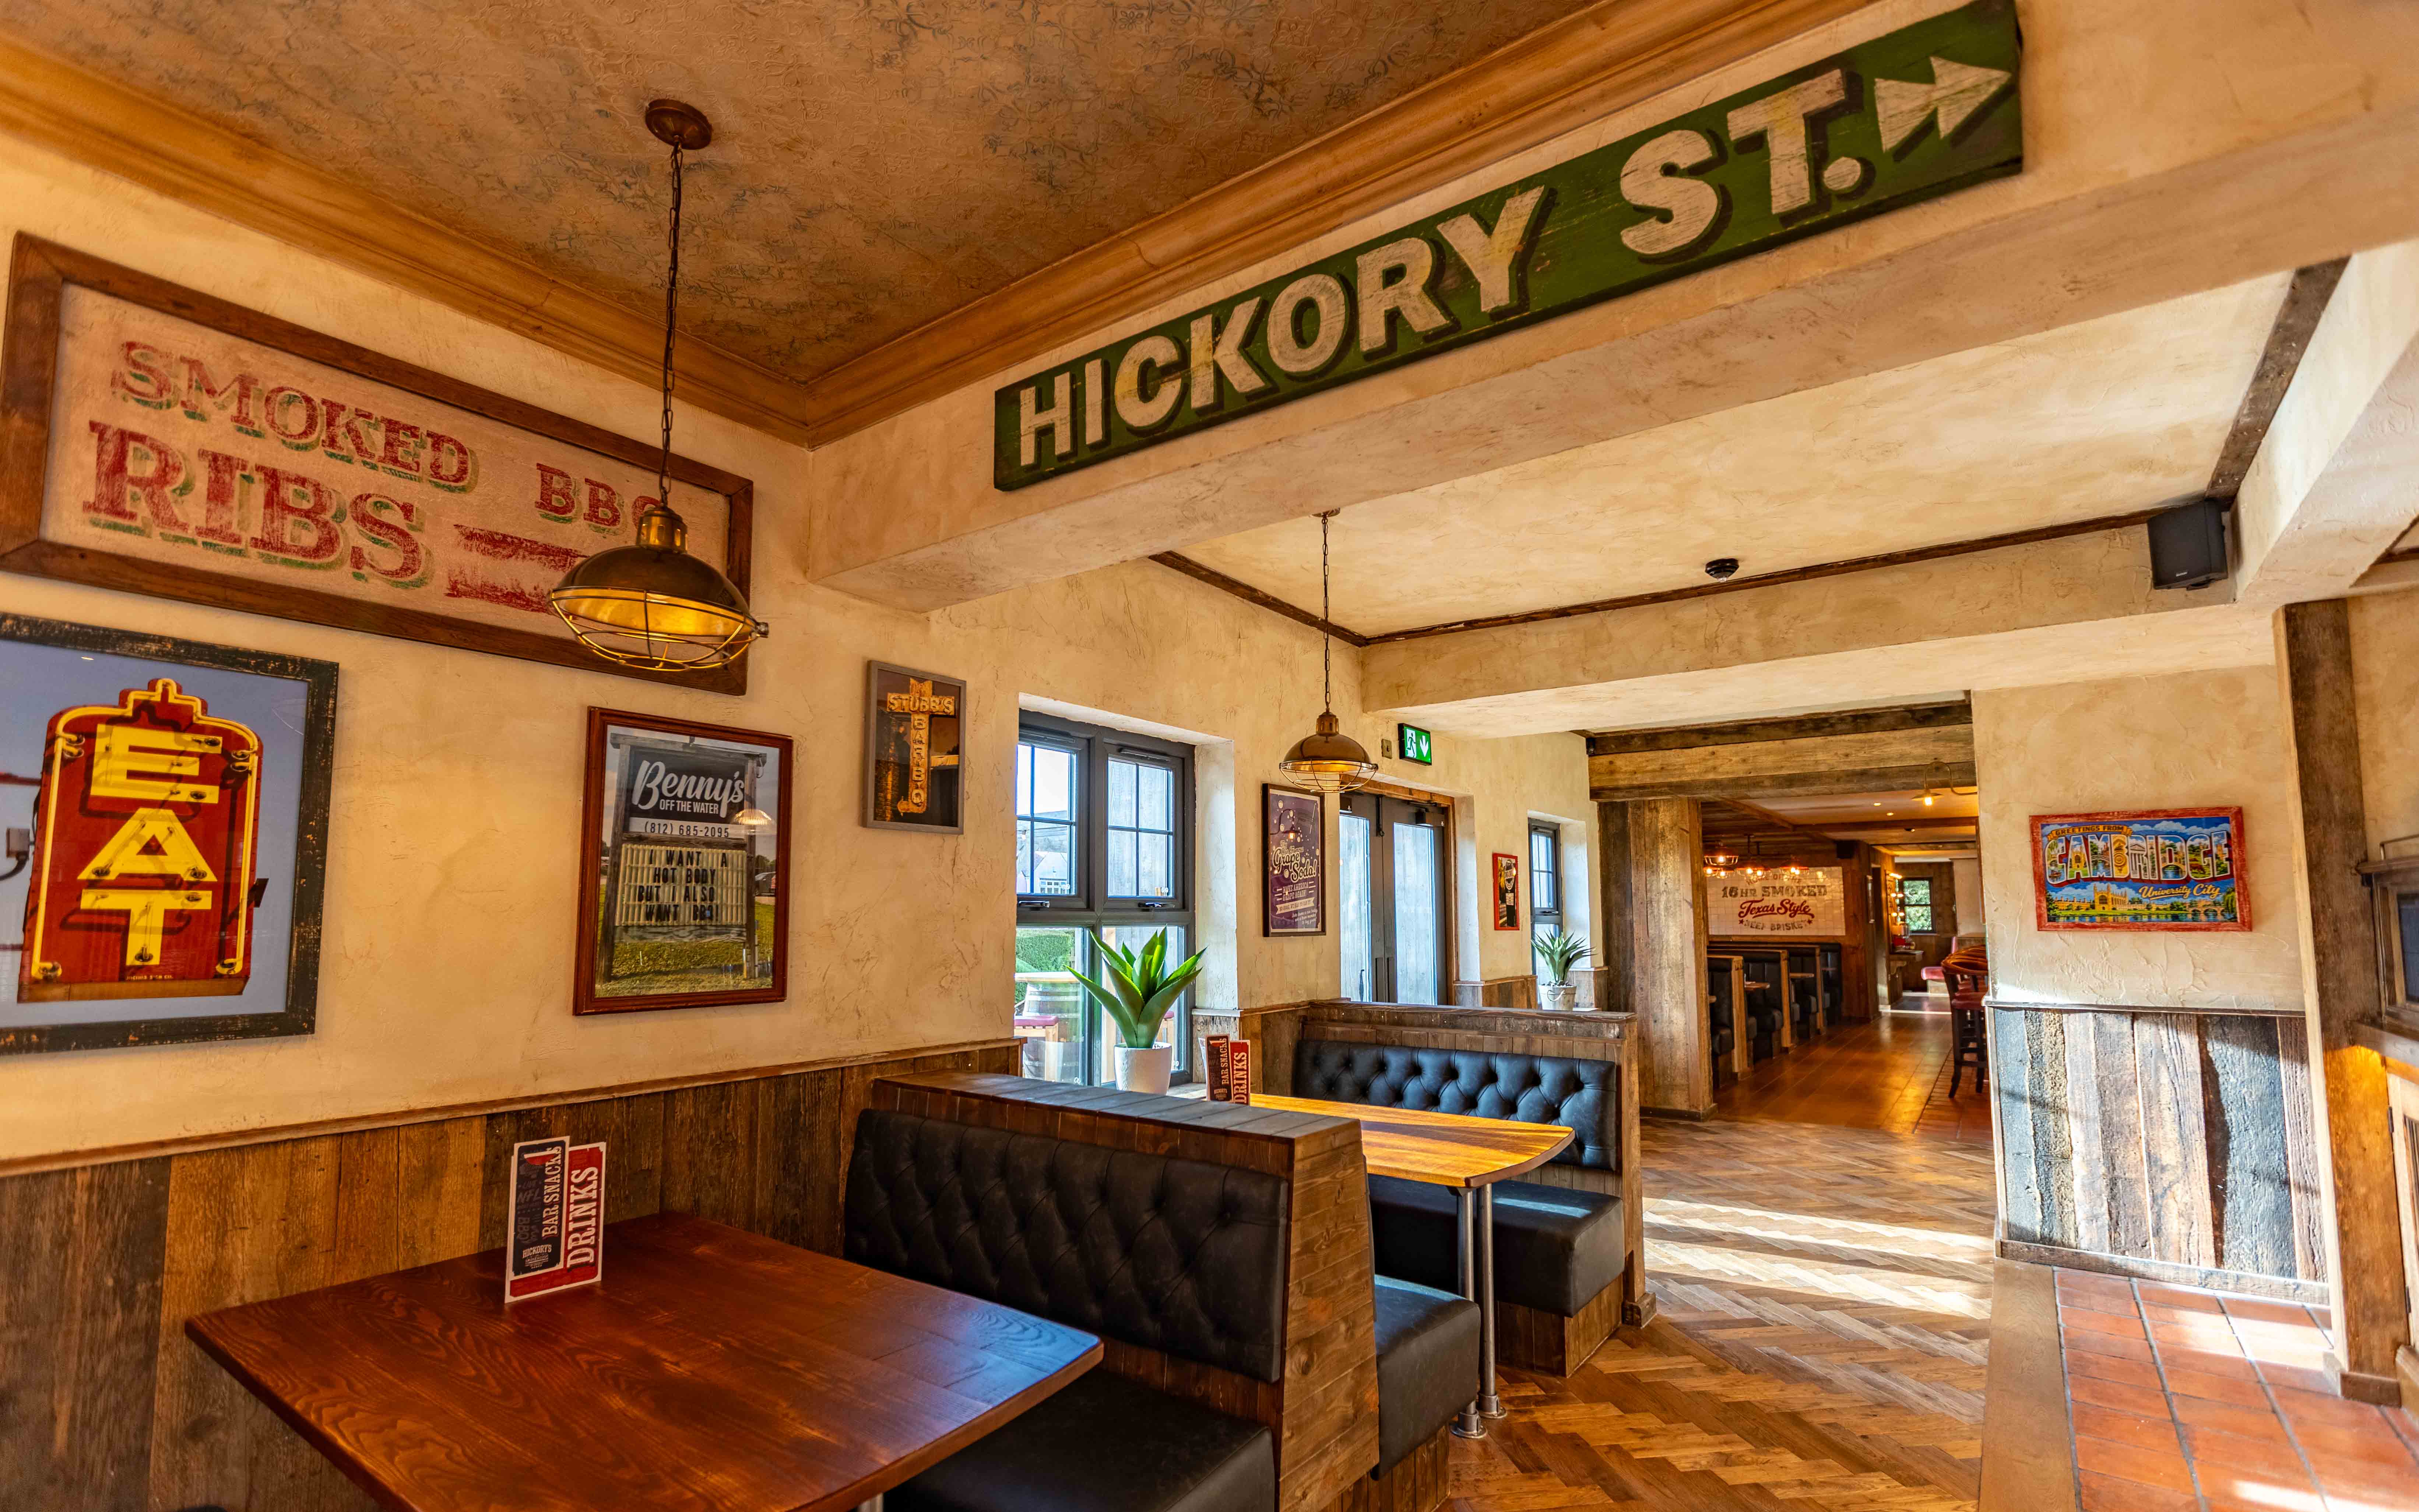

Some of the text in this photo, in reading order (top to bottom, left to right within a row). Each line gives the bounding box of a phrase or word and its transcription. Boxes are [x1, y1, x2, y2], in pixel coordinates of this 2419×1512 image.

[1019, 67, 1864, 466] HICKORY ST.
[111, 341, 473, 488] SMOKED
[83, 420, 425, 583] RIBS
[888, 695, 953, 714] STUBB'S
[632, 760, 745, 818] Benny's
[660, 799, 718, 814] OFF THE WATER
[645, 821, 729, 837] (812) 685-2095
[2056, 825, 2100, 835] GREETINGS
[77, 723, 223, 966] EAT
[650, 849, 727, 867] I WANT A
[1273, 847, 1300, 874] Grape
[2045, 831, 2232, 885] CAMBRIDGE
[654, 867, 715, 884] HOT BODY
[1290, 859, 1317, 883] Soda!
[638, 885, 715, 902] BUT I ALSO
[1293, 882, 1308, 891] AMERICA
[1762, 885, 1827, 897] SMOKED
[2138, 884, 2221, 900] University City
[646, 904, 679, 921] WANT
[1738, 898, 1815, 918] Texas Style
[1220, 1038, 1229, 1084] BAR SNACKS
[1234, 1052, 1247, 1103] DRINKS
[542, 1146, 562, 1237] BAR SNACKS
[566, 1167, 598, 1269] DRINKS
